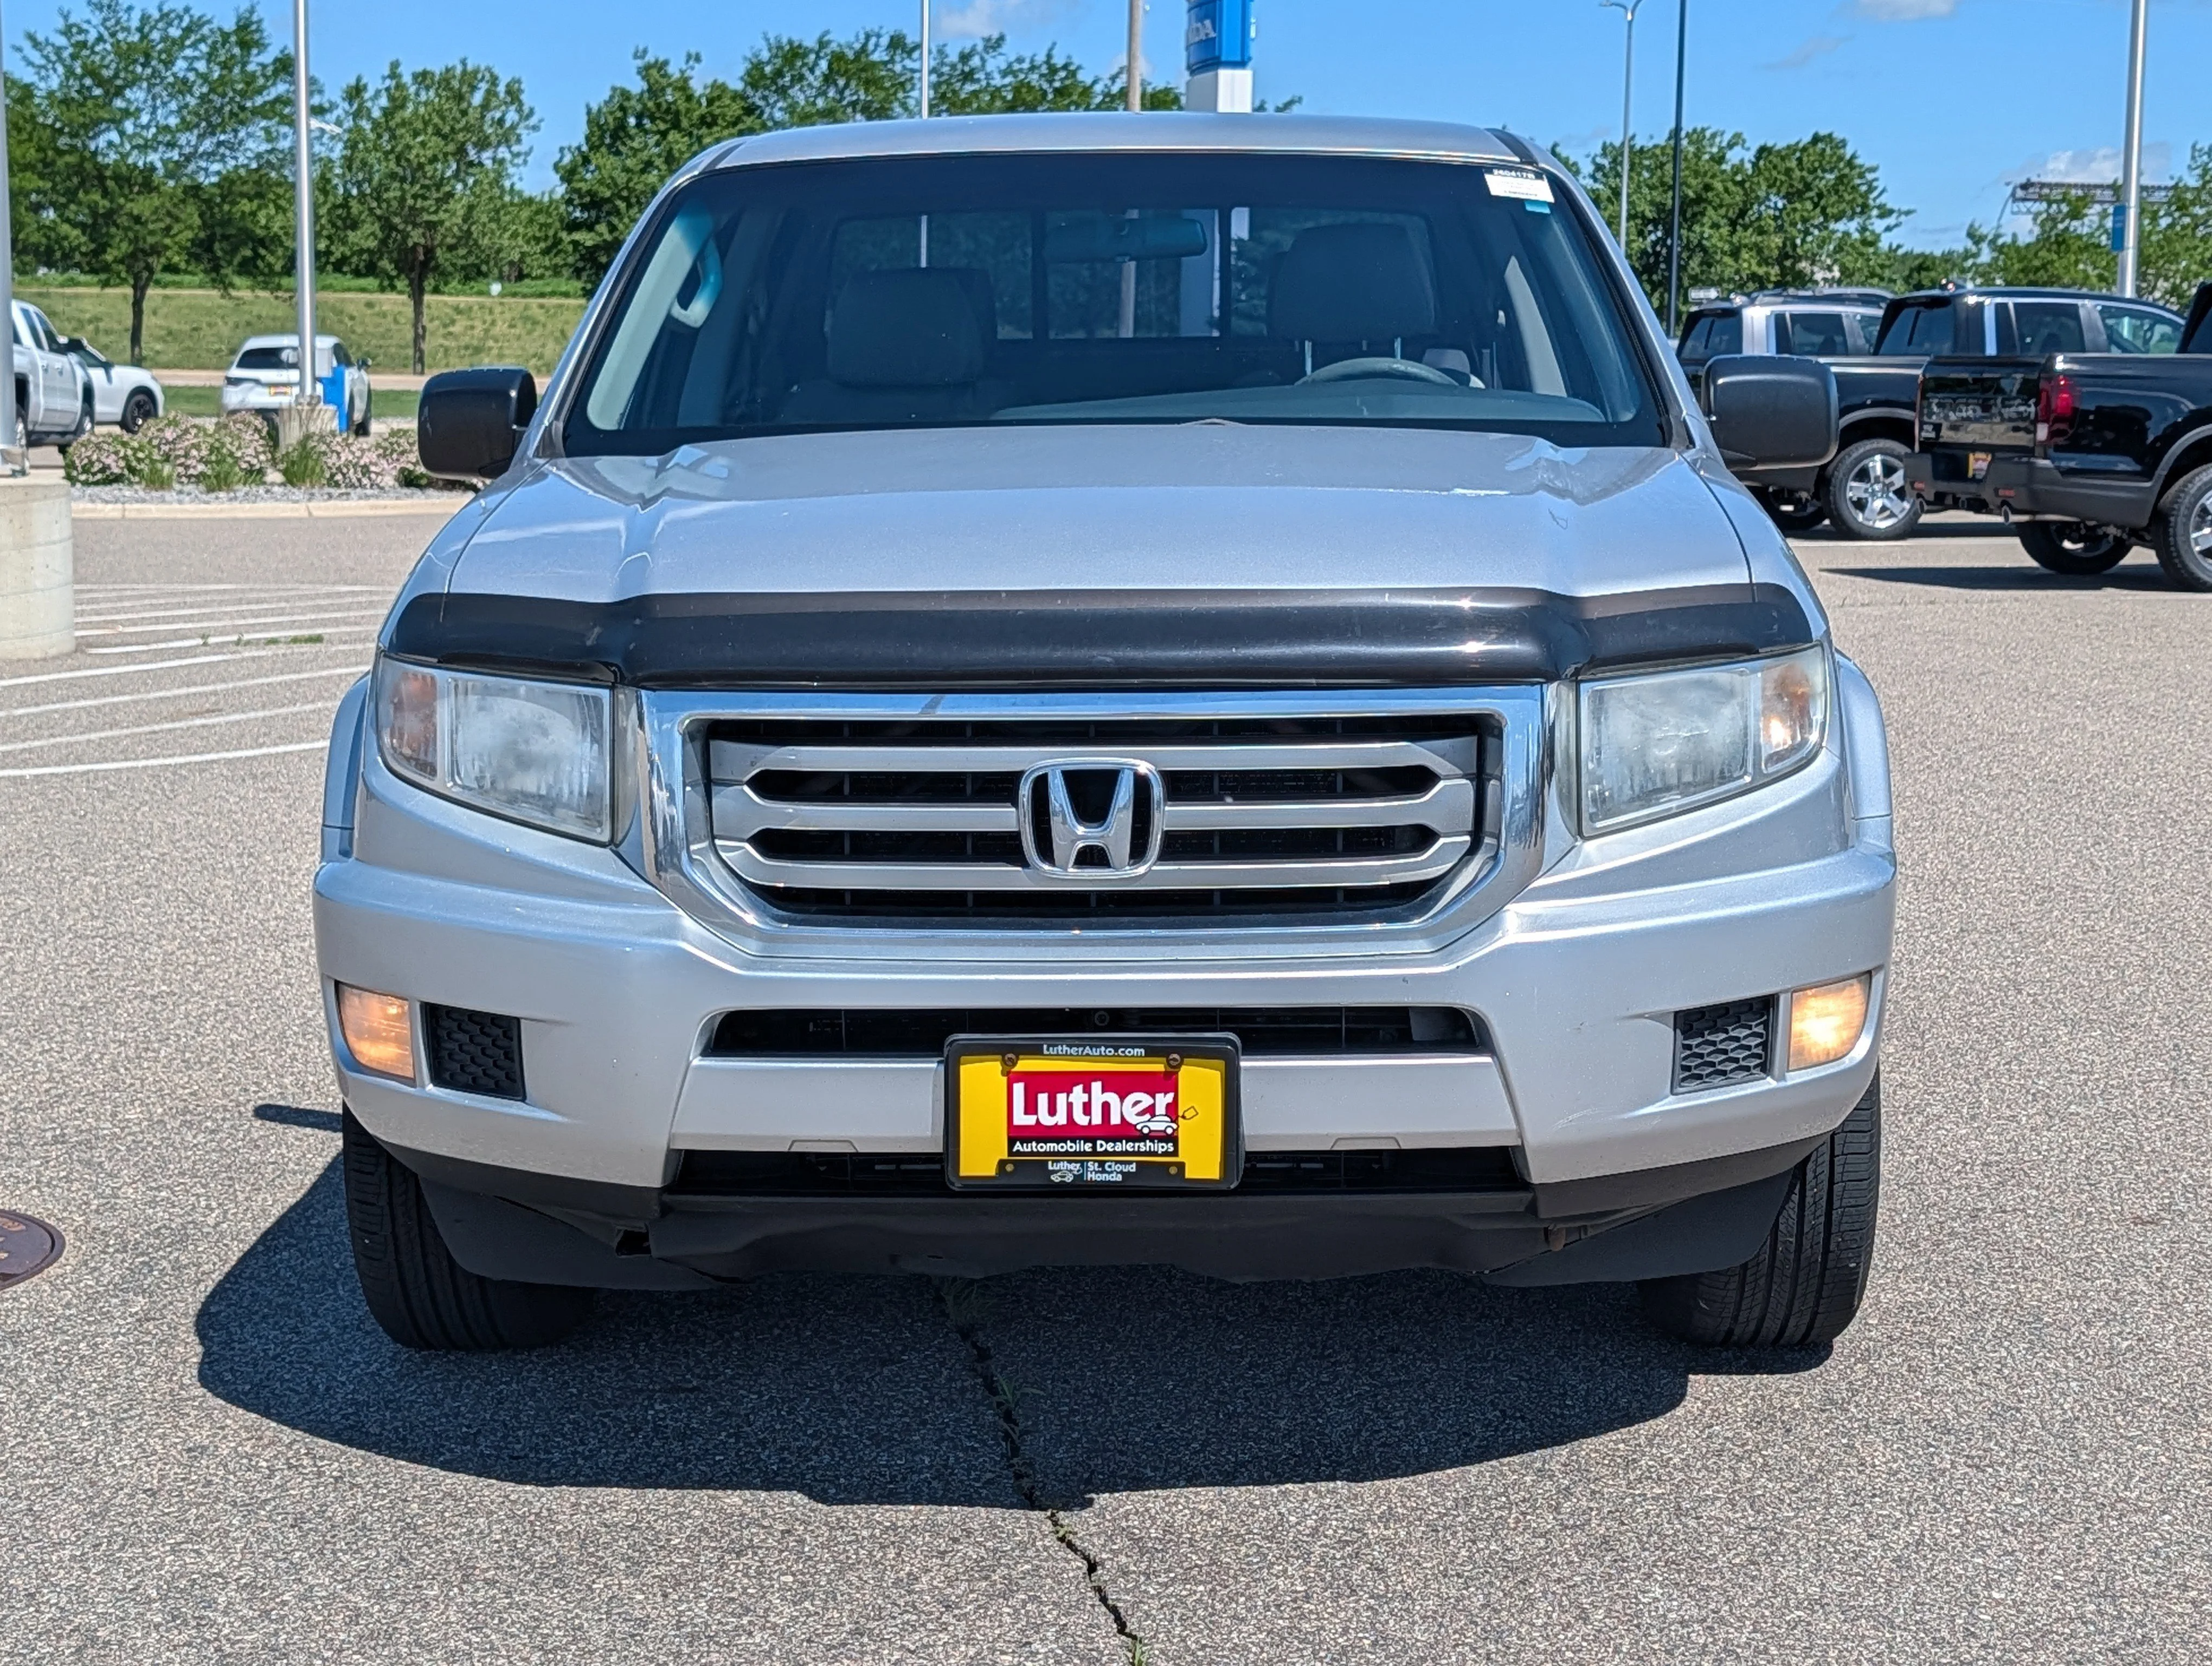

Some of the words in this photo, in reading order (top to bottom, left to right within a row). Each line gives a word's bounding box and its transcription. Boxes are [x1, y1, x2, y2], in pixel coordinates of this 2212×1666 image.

[1043, 1044, 1145, 1057] LutherAuto.com
[1012, 1081, 1174, 1126] Luther
[1013, 1140, 1092, 1153] Automobile
[1097, 1140, 1174, 1154] Dealerships
[1048, 1161, 1081, 1170] Luther
[1088, 1162, 1102, 1171] St.
[1104, 1162, 1136, 1172] Cloud
[1088, 1171, 1122, 1181] Honda
